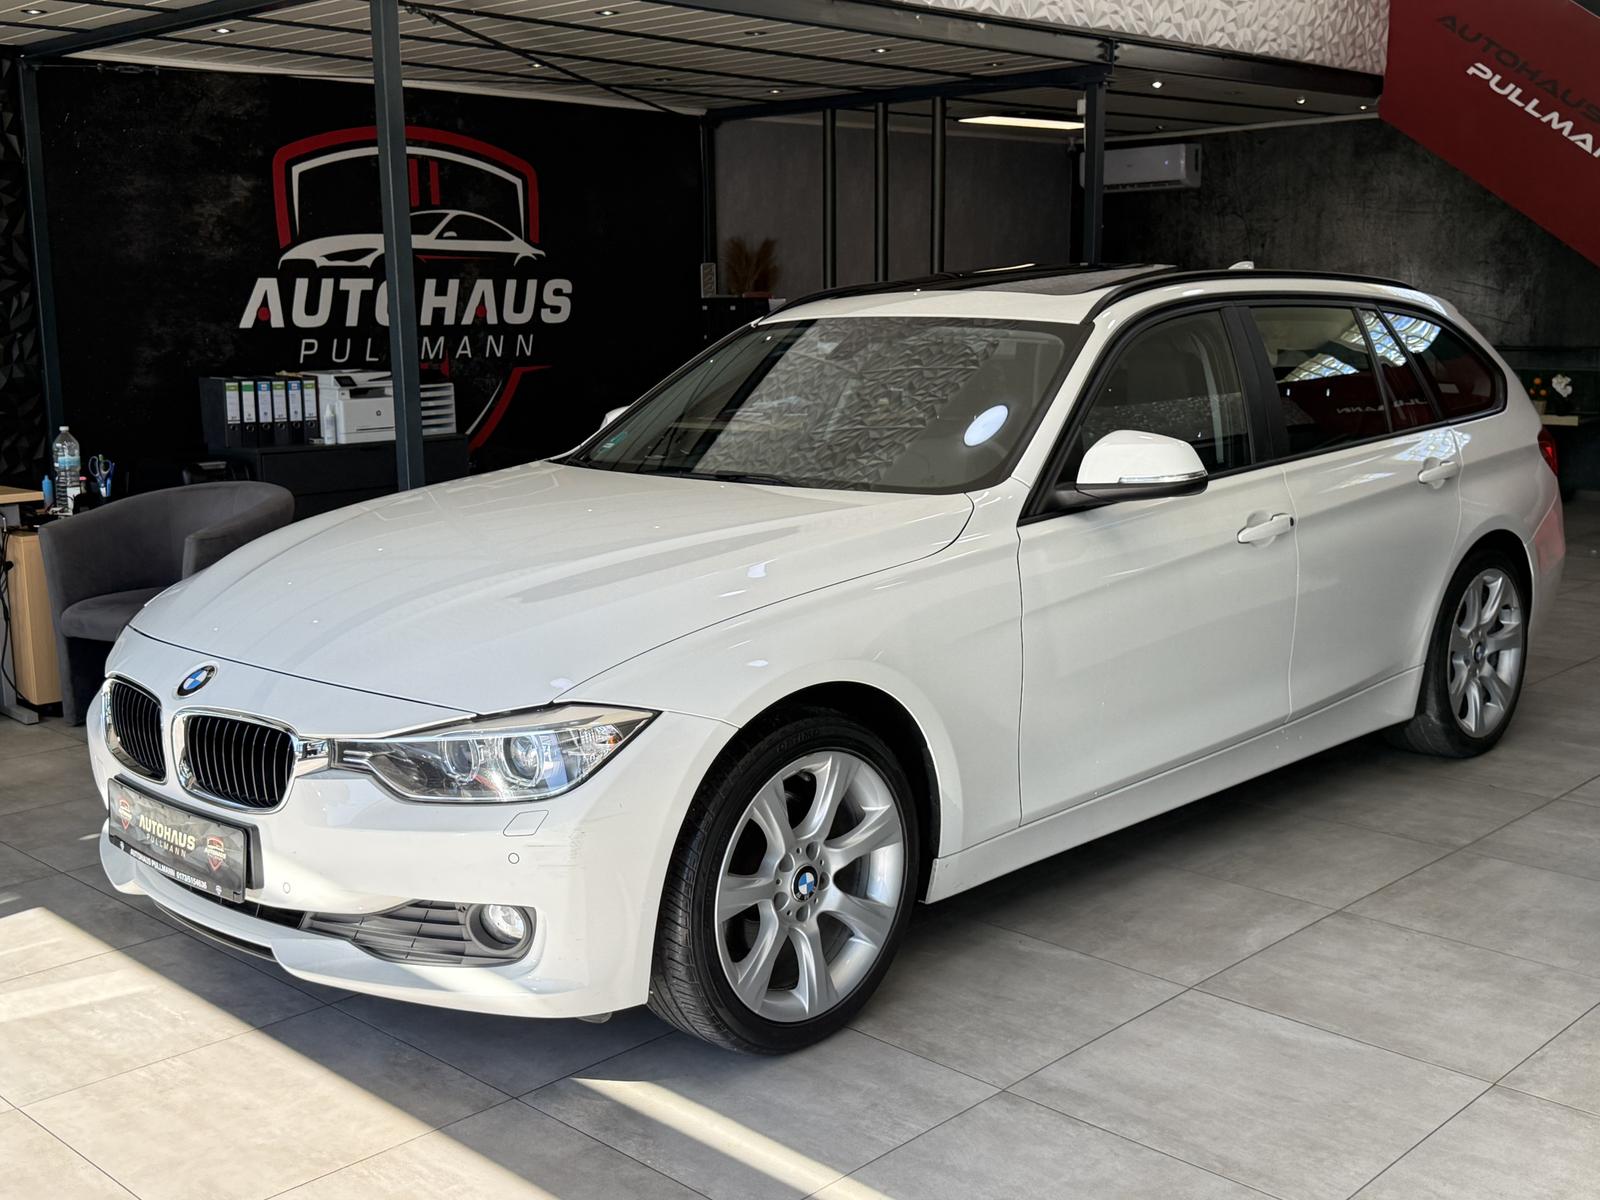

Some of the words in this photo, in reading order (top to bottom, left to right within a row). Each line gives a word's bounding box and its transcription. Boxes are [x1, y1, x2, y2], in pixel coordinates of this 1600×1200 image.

[1466, 62, 1600, 158] PULLMA
[300, 333, 534, 364] PULMANN
[138, 814, 196, 851] AUTOHAUS
